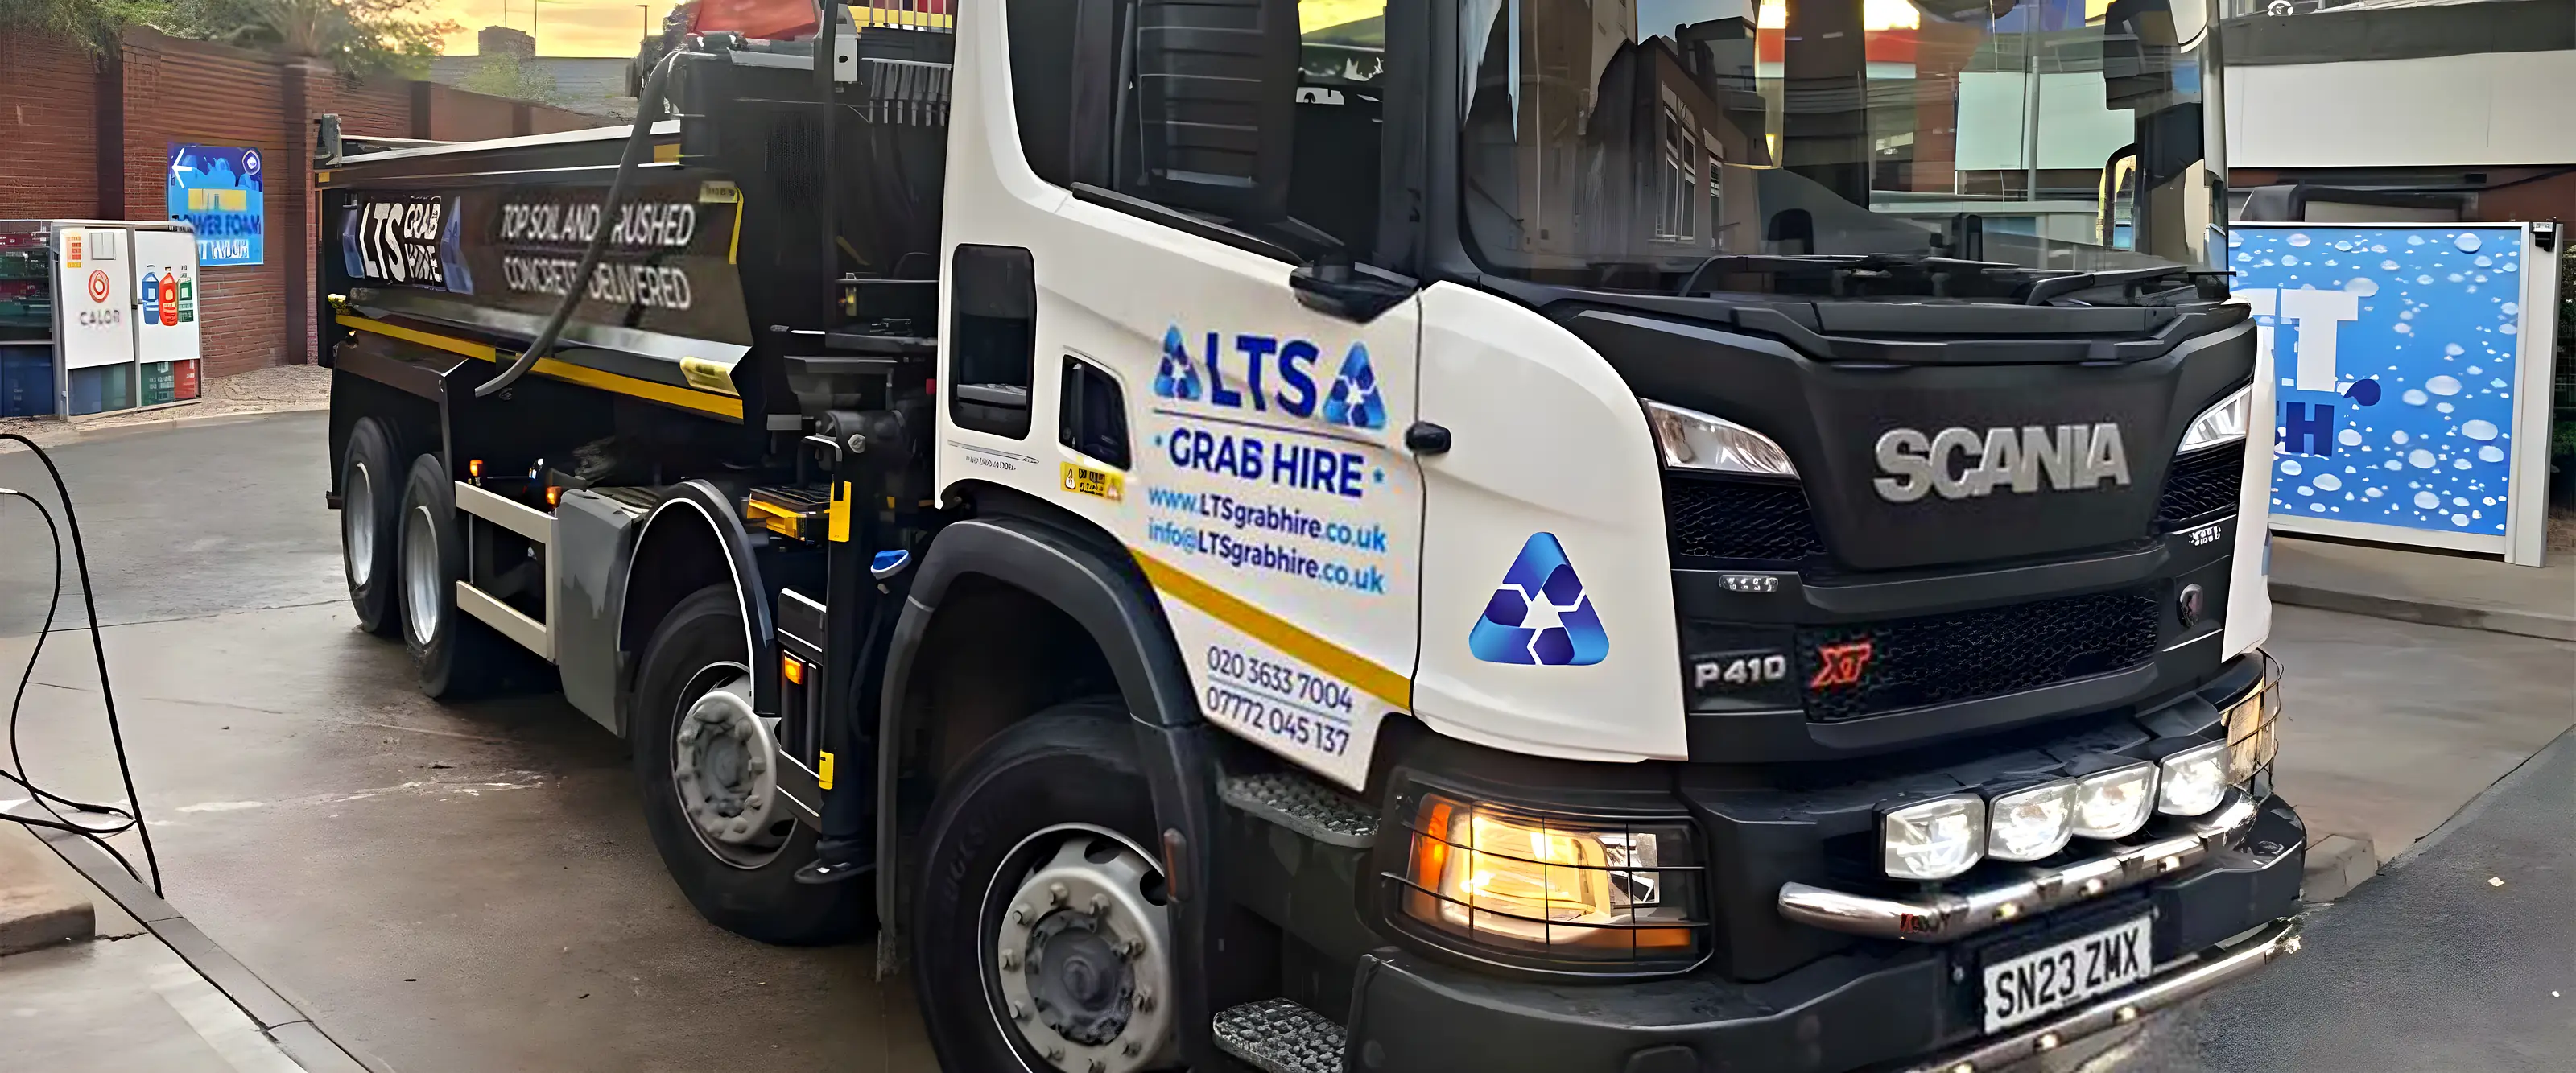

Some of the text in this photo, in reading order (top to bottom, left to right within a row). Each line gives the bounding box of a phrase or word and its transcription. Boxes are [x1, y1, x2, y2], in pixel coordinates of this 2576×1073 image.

[359, 202, 405, 282] LTS
[560, 204, 601, 241] AND
[610, 203, 696, 246] RUSHED
[79, 309, 121, 325] CALOR
[1205, 332, 1320, 419] LTS
[1169, 427, 1364, 498] GRAB HIRE
[1873, 423, 2132, 502] SCANIA
[1147, 486, 1387, 552] www.LTSgrabhire.co.uk
[1147, 517, 1385, 595] info@LTSgrabhire.co.uk
[1208, 646, 1353, 713] 020 3633 7004
[1810, 642, 1872, 691] XT
[1207, 686, 1350, 757] 07772 045 137
[1996, 926, 2140, 1019] SN23 ZMX
